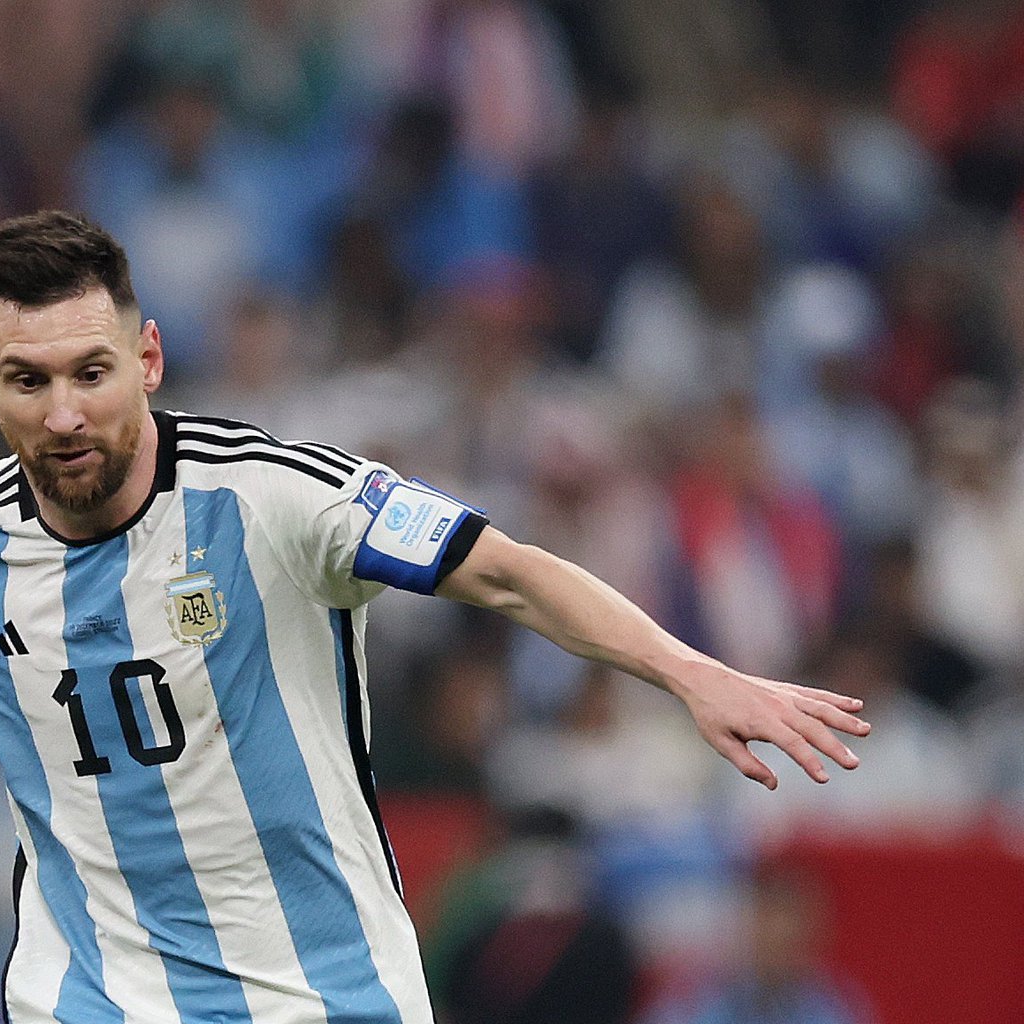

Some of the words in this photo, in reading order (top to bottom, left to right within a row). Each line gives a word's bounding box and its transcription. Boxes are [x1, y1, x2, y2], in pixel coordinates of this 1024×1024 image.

[432, 519, 448, 540] FIFA
[181, 592, 213, 626] AFA
[51, 658, 186, 777] 10
